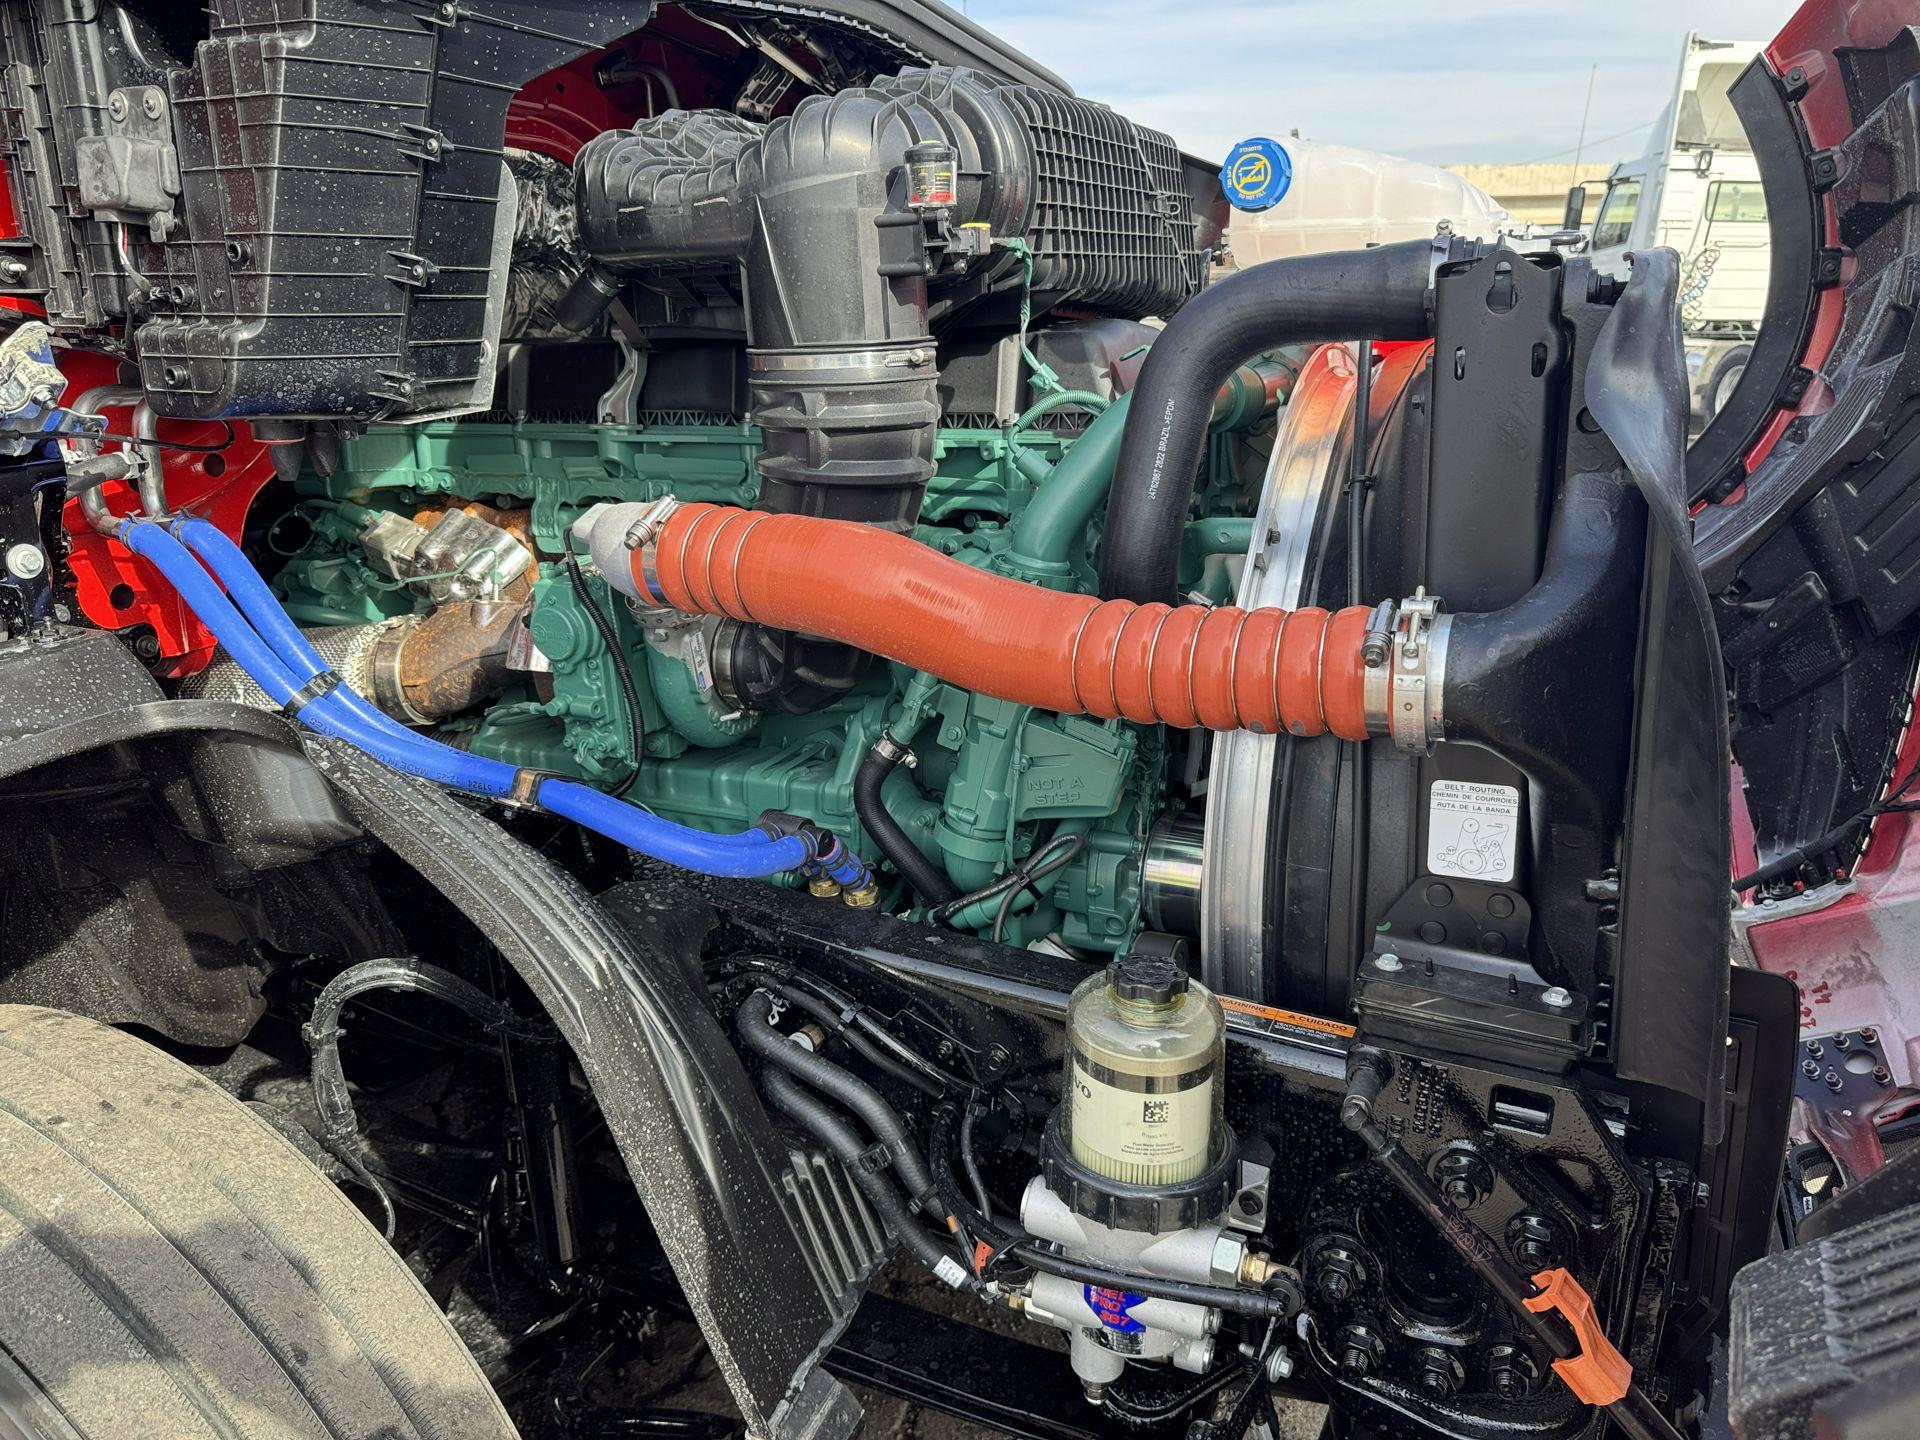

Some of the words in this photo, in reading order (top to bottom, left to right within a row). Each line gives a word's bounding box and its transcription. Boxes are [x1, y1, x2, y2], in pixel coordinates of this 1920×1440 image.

[1158, 425, 1171, 452] BRAZIL
[387, 756, 398, 767] IN
[403, 762, 429, 776] MADE
[1027, 777, 1065, 791] NOT
[1072, 776, 1086, 789] A
[1469, 785, 1506, 795] ROUTING
[1034, 791, 1081, 805] STEP
[1431, 791, 1459, 799] CHEMIN
[1475, 795, 1518, 805] COURROIES
[1437, 801, 1456, 809] RUTA
[1485, 806, 1511, 814] BANDA
[1219, 998, 1266, 1013] WARNING
[1298, 1016, 1348, 1031] CUIDADO
[1090, 1291, 1121, 1312] PRO
